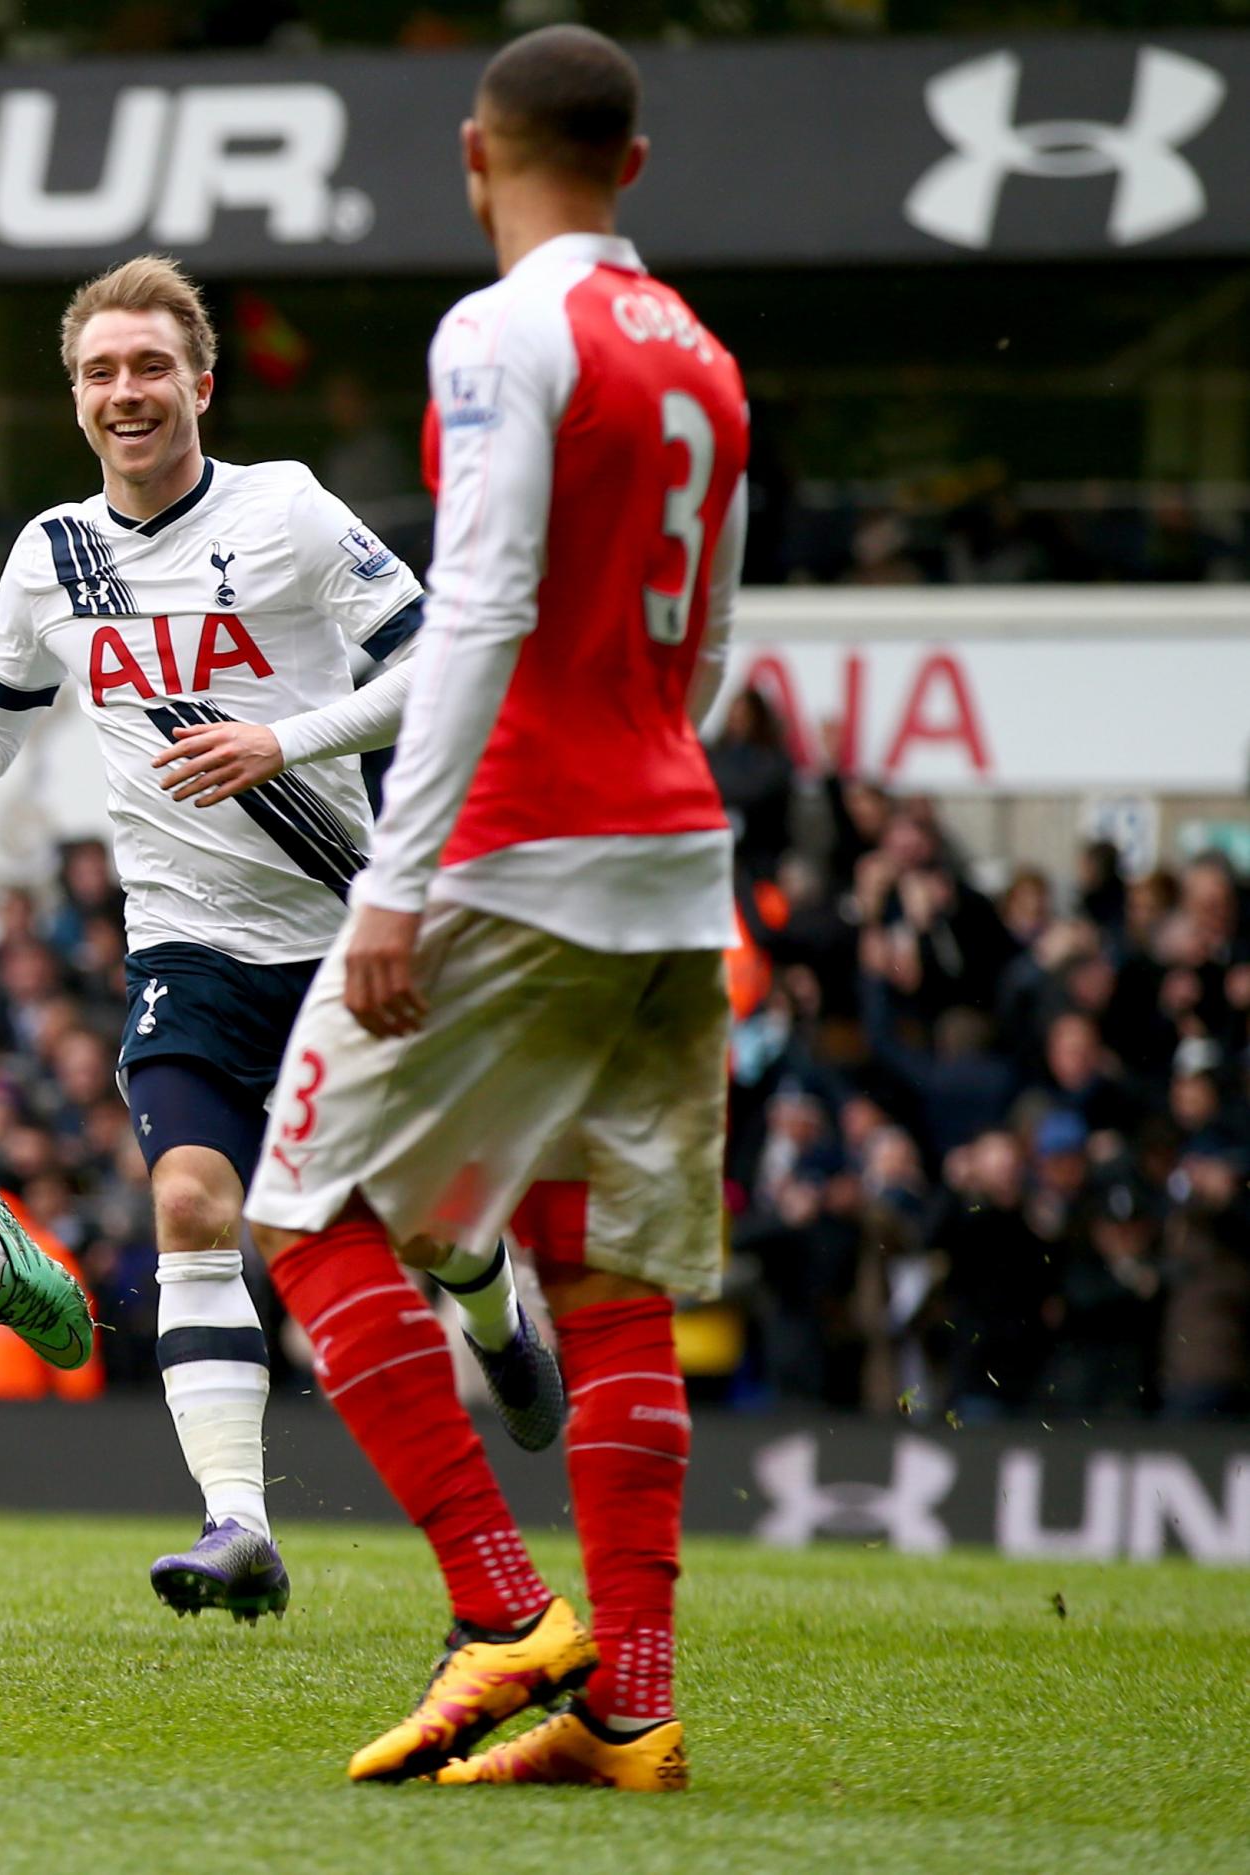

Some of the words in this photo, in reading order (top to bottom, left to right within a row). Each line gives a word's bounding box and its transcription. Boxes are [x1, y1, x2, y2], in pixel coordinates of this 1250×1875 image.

[643, 390, 715, 643] 3
[89, 612, 275, 708] AIA
[282, 1050, 327, 1142] 3
[996, 1451, 1250, 1565] UN
